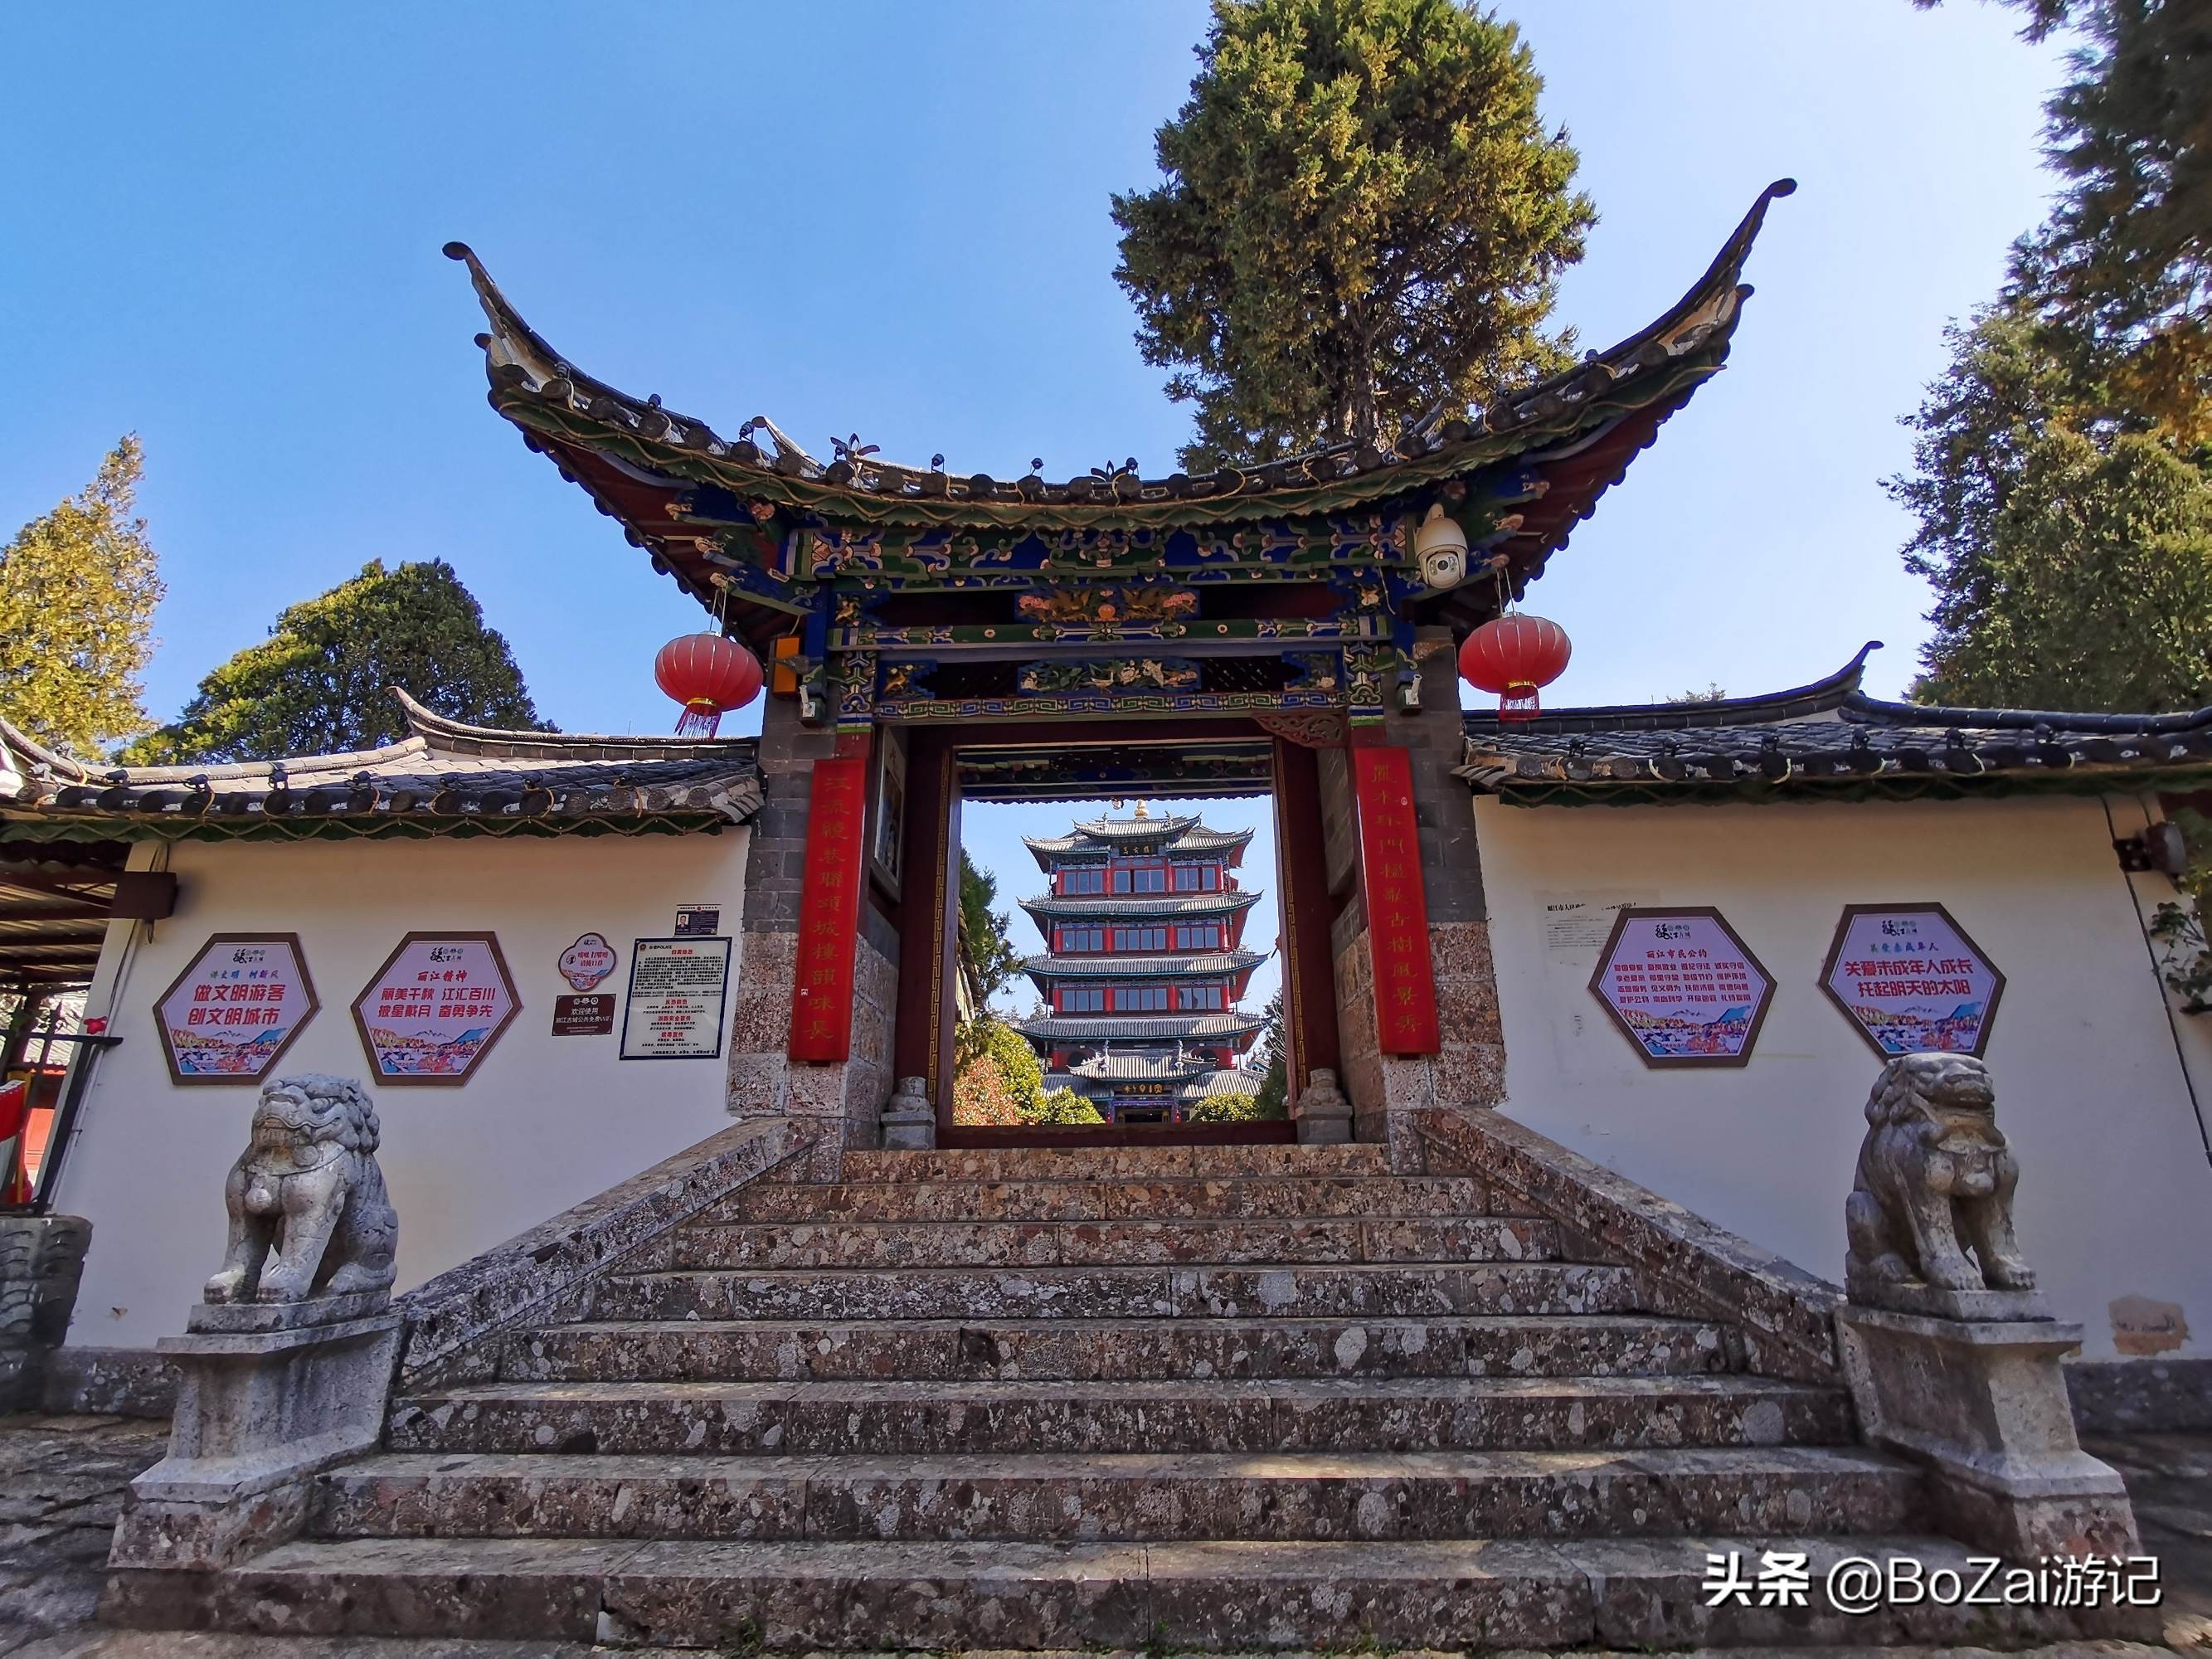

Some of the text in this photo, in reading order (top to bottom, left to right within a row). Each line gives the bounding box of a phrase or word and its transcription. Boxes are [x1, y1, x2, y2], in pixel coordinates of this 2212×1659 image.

[1646, 949, 1707, 958] 丽江市民公约
[1845, 958, 1974, 977] 关爱未成年人成长
[417, 970, 468, 982] 丽江精神
[193, 984, 286, 1002] 做文明游客
[381, 987, 496, 1001] 丽美千秋 江汇百川
[1857, 979, 1971, 997] 托起明天的太阳
[187, 1007, 280, 1025] 创文明城市
[378, 1005, 493, 1018] 披星戴月 奋勇争先
